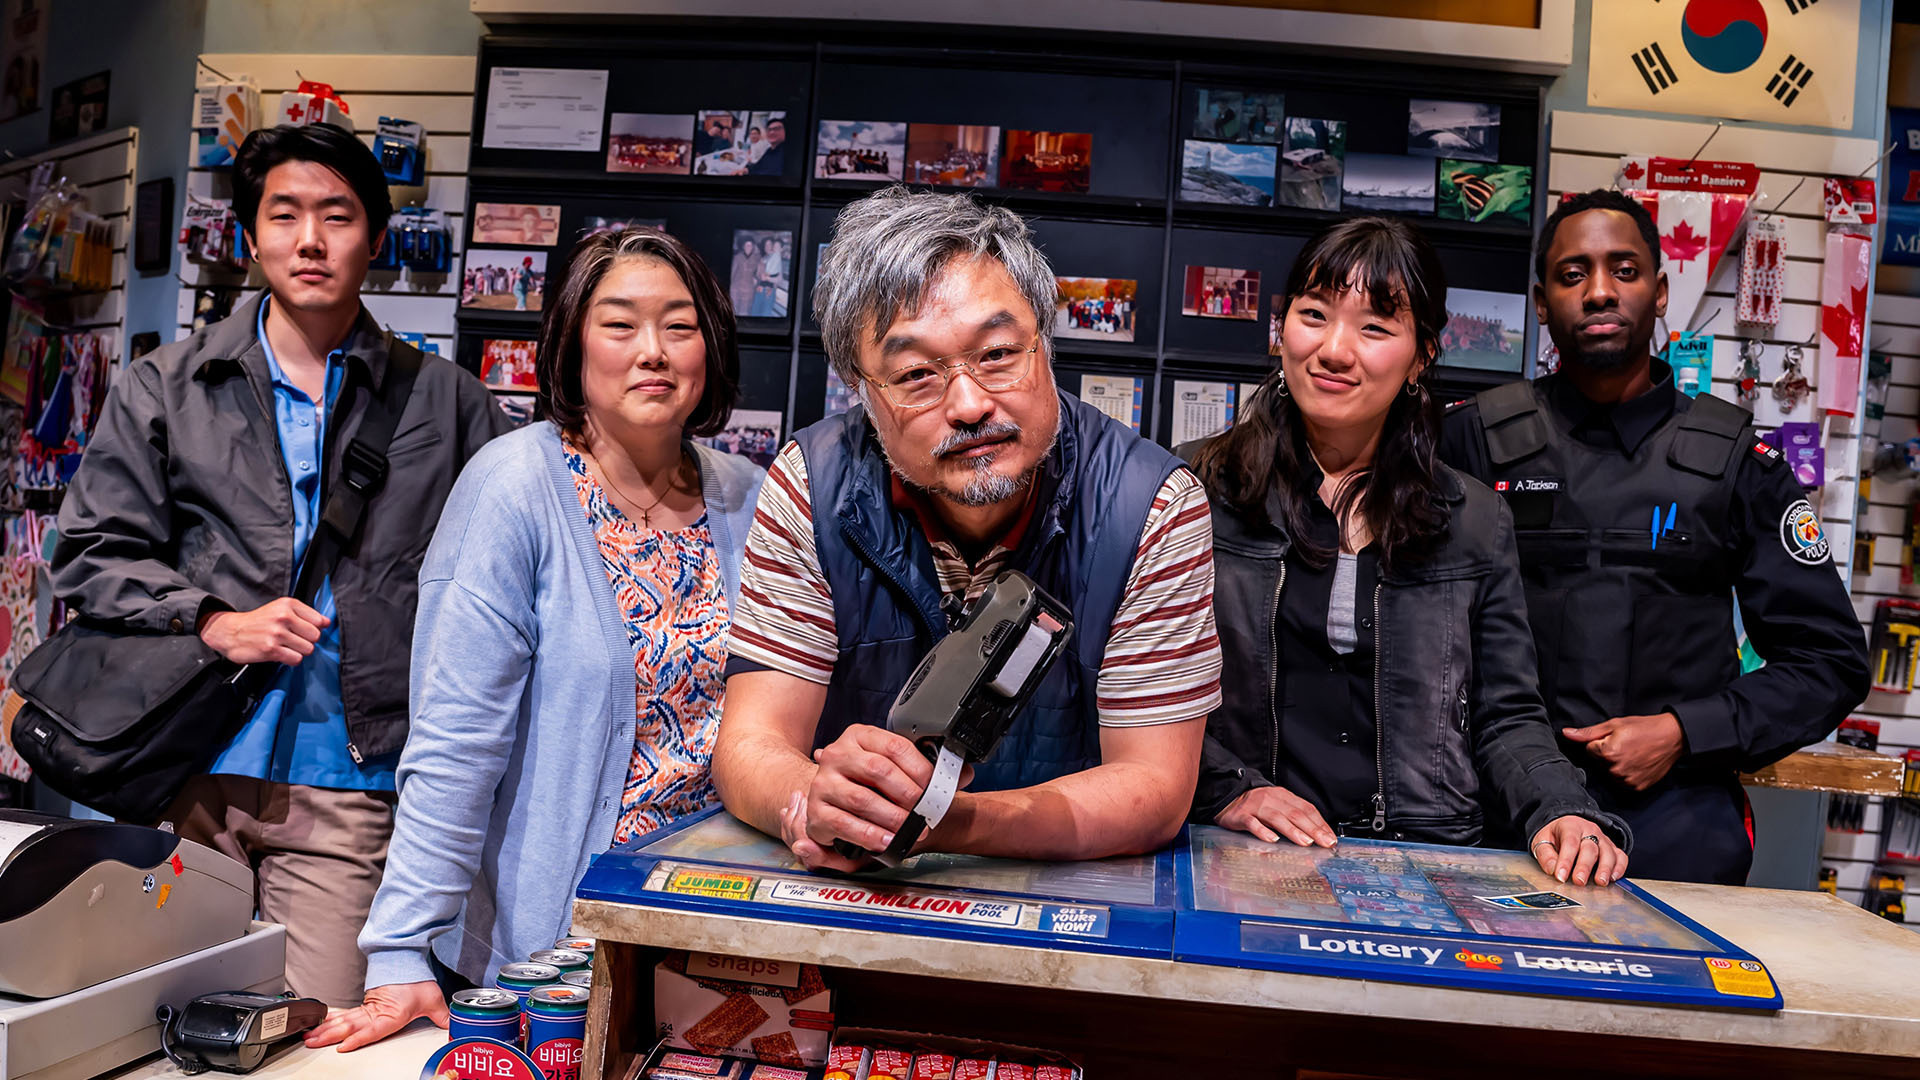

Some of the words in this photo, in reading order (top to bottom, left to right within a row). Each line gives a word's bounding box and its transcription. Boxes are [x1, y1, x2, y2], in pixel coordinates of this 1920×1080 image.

[1655, 172, 1691, 184] Banner
[1701, 173, 1746, 187] Bannière
[1515, 480, 1525, 491] A
[1525, 479, 1559, 491] Jackson
[679, 876, 745, 891] JUMBO
[818, 887, 866, 903] $100
[865, 892, 972, 915] MILLION
[974, 902, 1010, 911] PRIZE
[969, 908, 1003, 918] POOL
[1051, 912, 1098, 923] YOURS
[1052, 921, 1093, 932] NOW!
[1299, 934, 1444, 966] Lottery
[1456, 952, 1503, 965] OLG
[1513, 951, 1654, 978] Loterie
[706, 954, 781, 976] snaps
[660, 1022, 673, 1032] 24
[472, 1046, 494, 1056] bibiyo
[454, 1052, 515, 1077] 비비요
